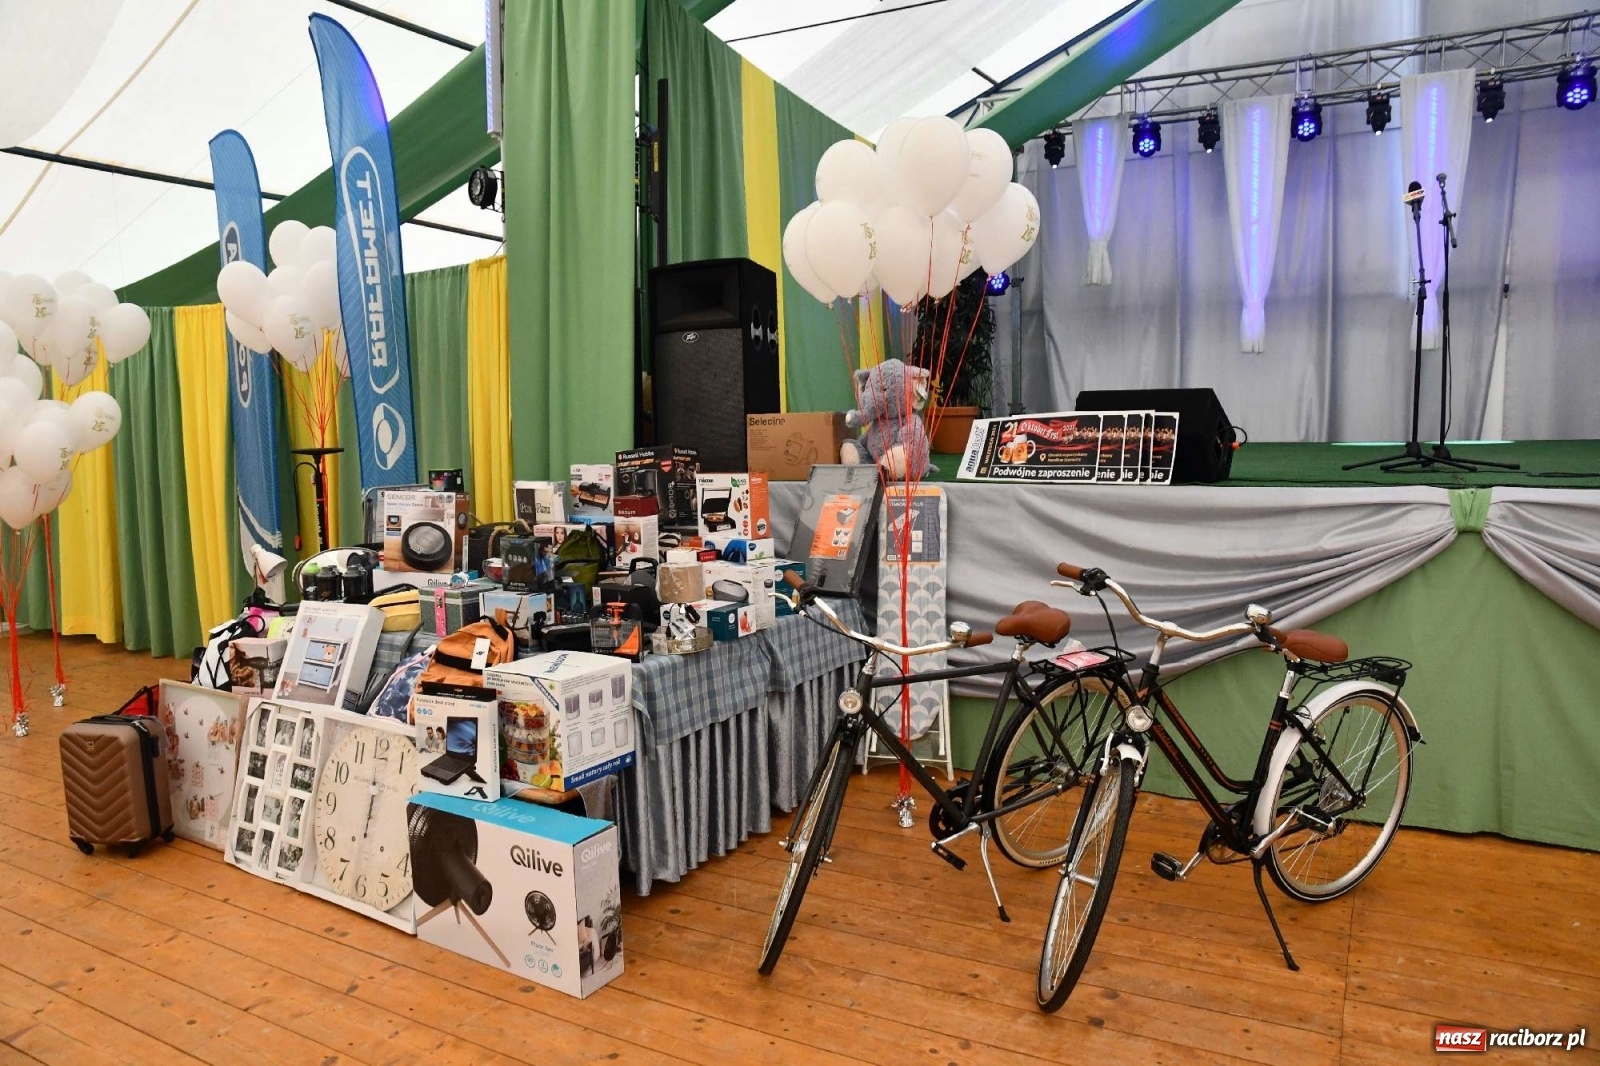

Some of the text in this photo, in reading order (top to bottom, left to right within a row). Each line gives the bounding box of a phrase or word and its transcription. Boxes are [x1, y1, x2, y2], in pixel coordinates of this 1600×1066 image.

[1002, 421, 1019, 439] 21
[992, 467, 1090, 478] Podwójne zaproszenie
[354, 741, 366, 764] 11
[373, 736, 389, 761] 12
[332, 761, 349, 785] 10
[326, 791, 338, 815] 9
[471, 801, 536, 824] Qilive
[323, 826, 336, 850] 8
[510, 845, 564, 877] Qilive
[581, 840, 612, 863] Qilive
[338, 856, 351, 880] 7
[396, 852, 410, 878] 4
[355, 874, 367, 898] 6
[377, 872, 389, 897] 5
